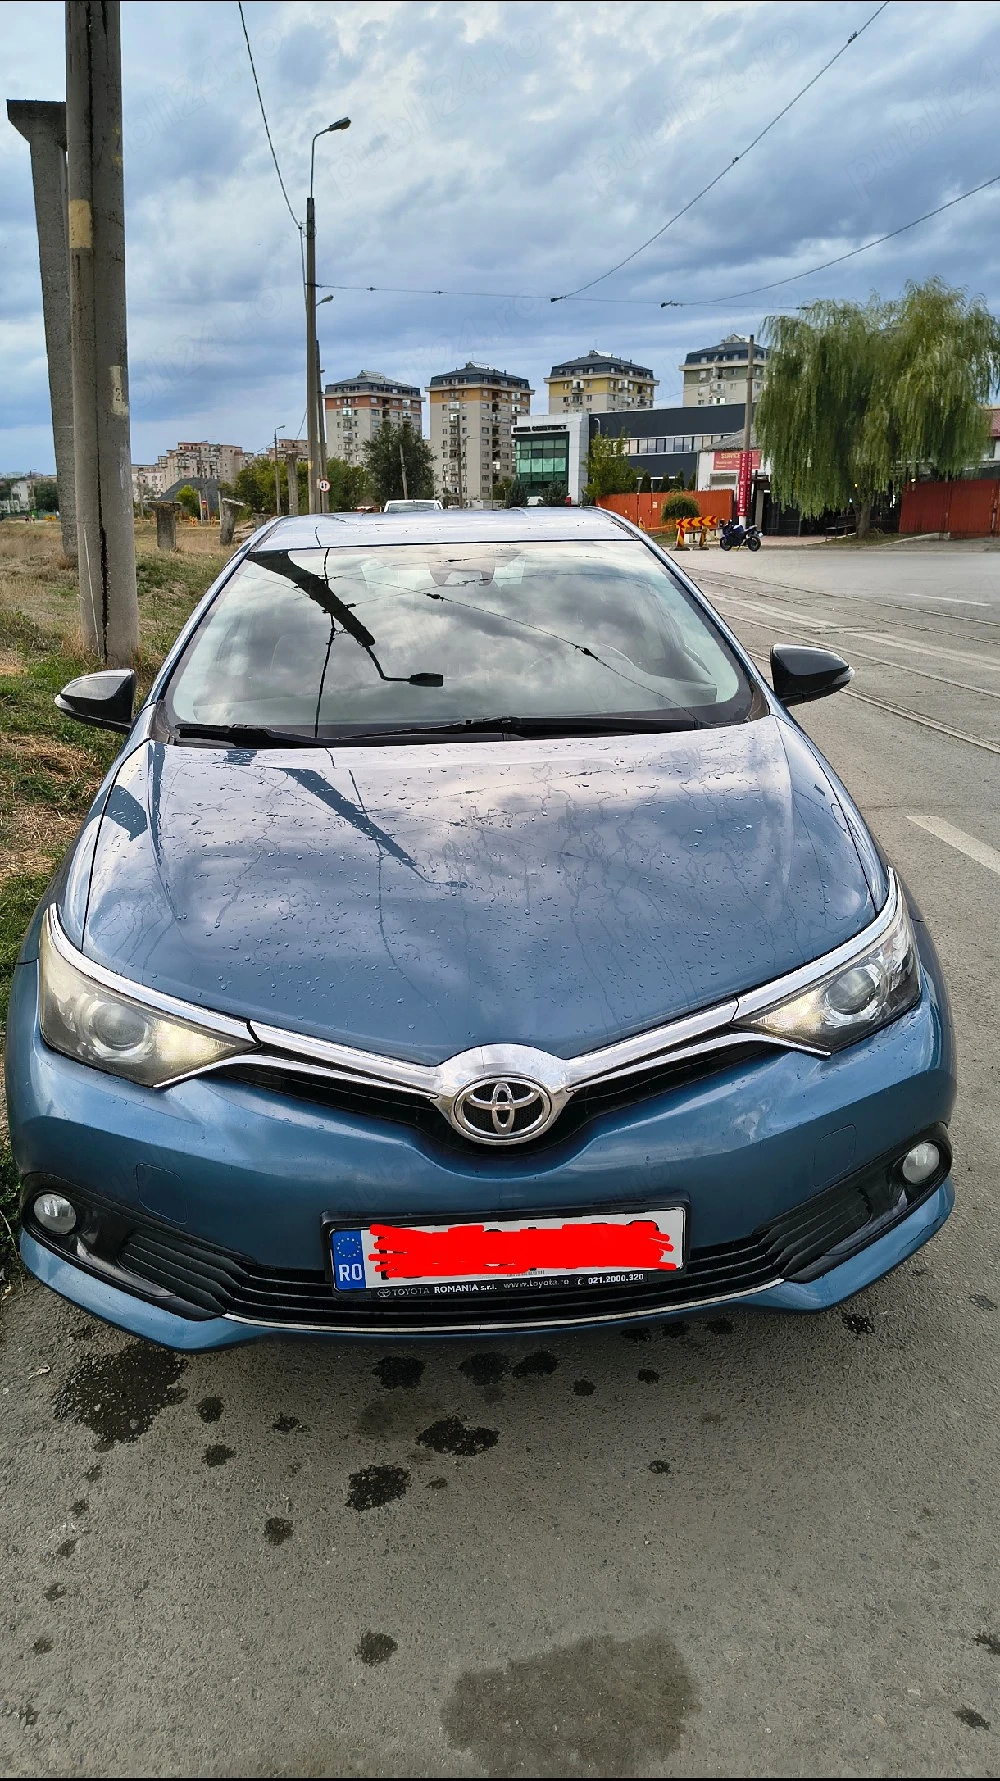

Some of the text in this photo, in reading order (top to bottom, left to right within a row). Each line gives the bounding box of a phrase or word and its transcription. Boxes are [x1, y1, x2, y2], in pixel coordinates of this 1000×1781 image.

[338, 1263, 363, 1282] RO
[393, 1287, 430, 1296] TOYOTA
[434, 1283, 479, 1294] ROMANIA
[587, 1273, 644, 1285] 021.2000.320
